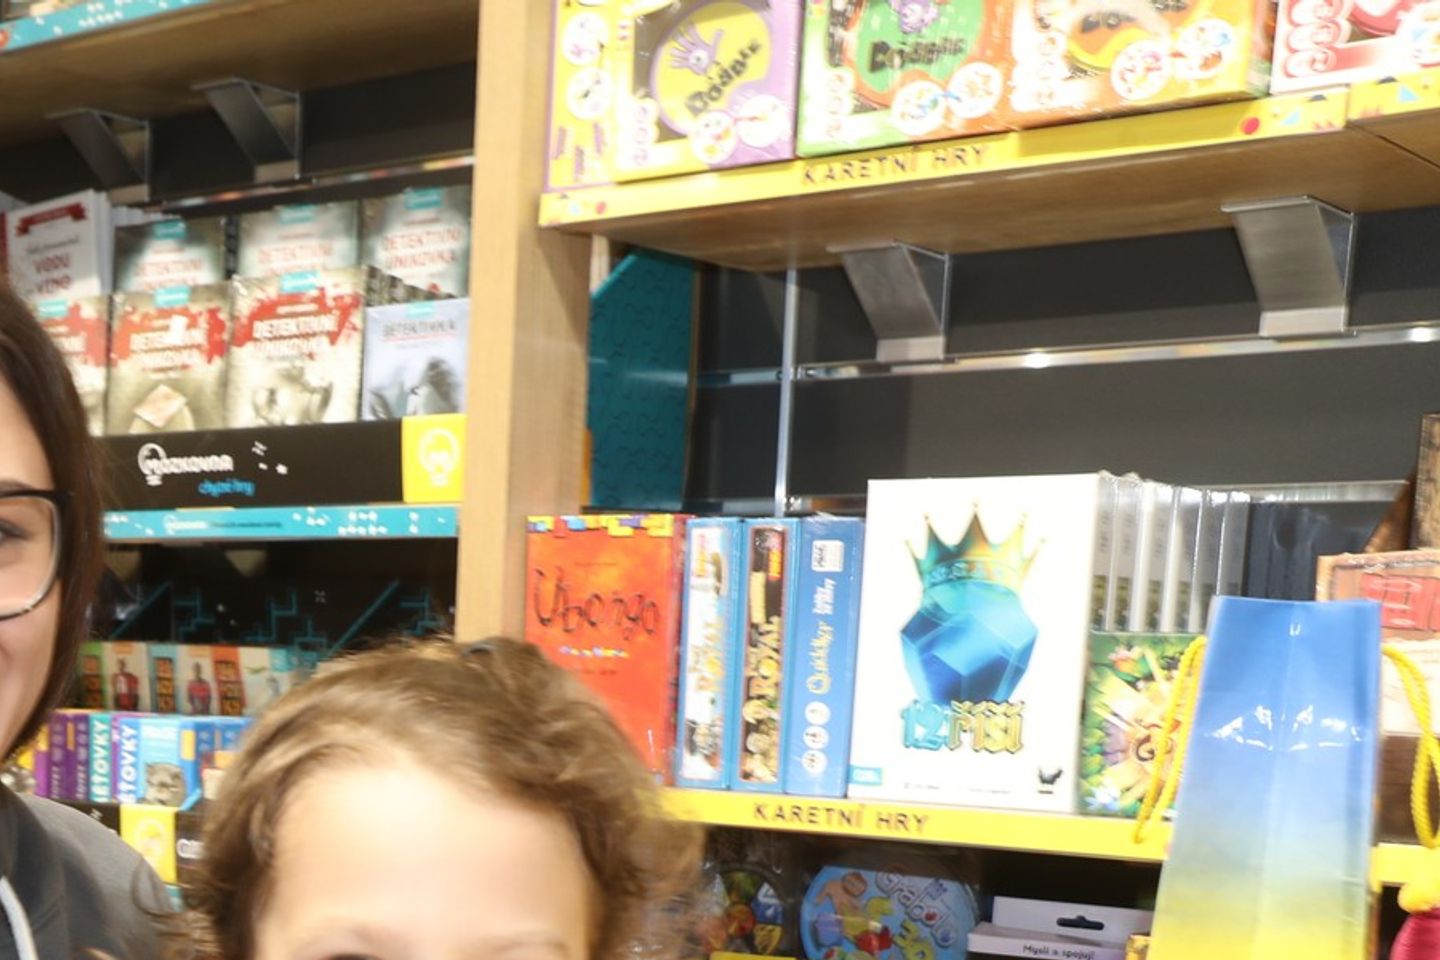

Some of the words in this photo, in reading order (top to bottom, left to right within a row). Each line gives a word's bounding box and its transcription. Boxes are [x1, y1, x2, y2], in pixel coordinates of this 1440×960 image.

[802, 146, 918, 185] KARETNÍ
[934, 144, 988, 169] HRY
[753, 803, 865, 828] KARETNÍ
[876, 812, 929, 834] HRY
